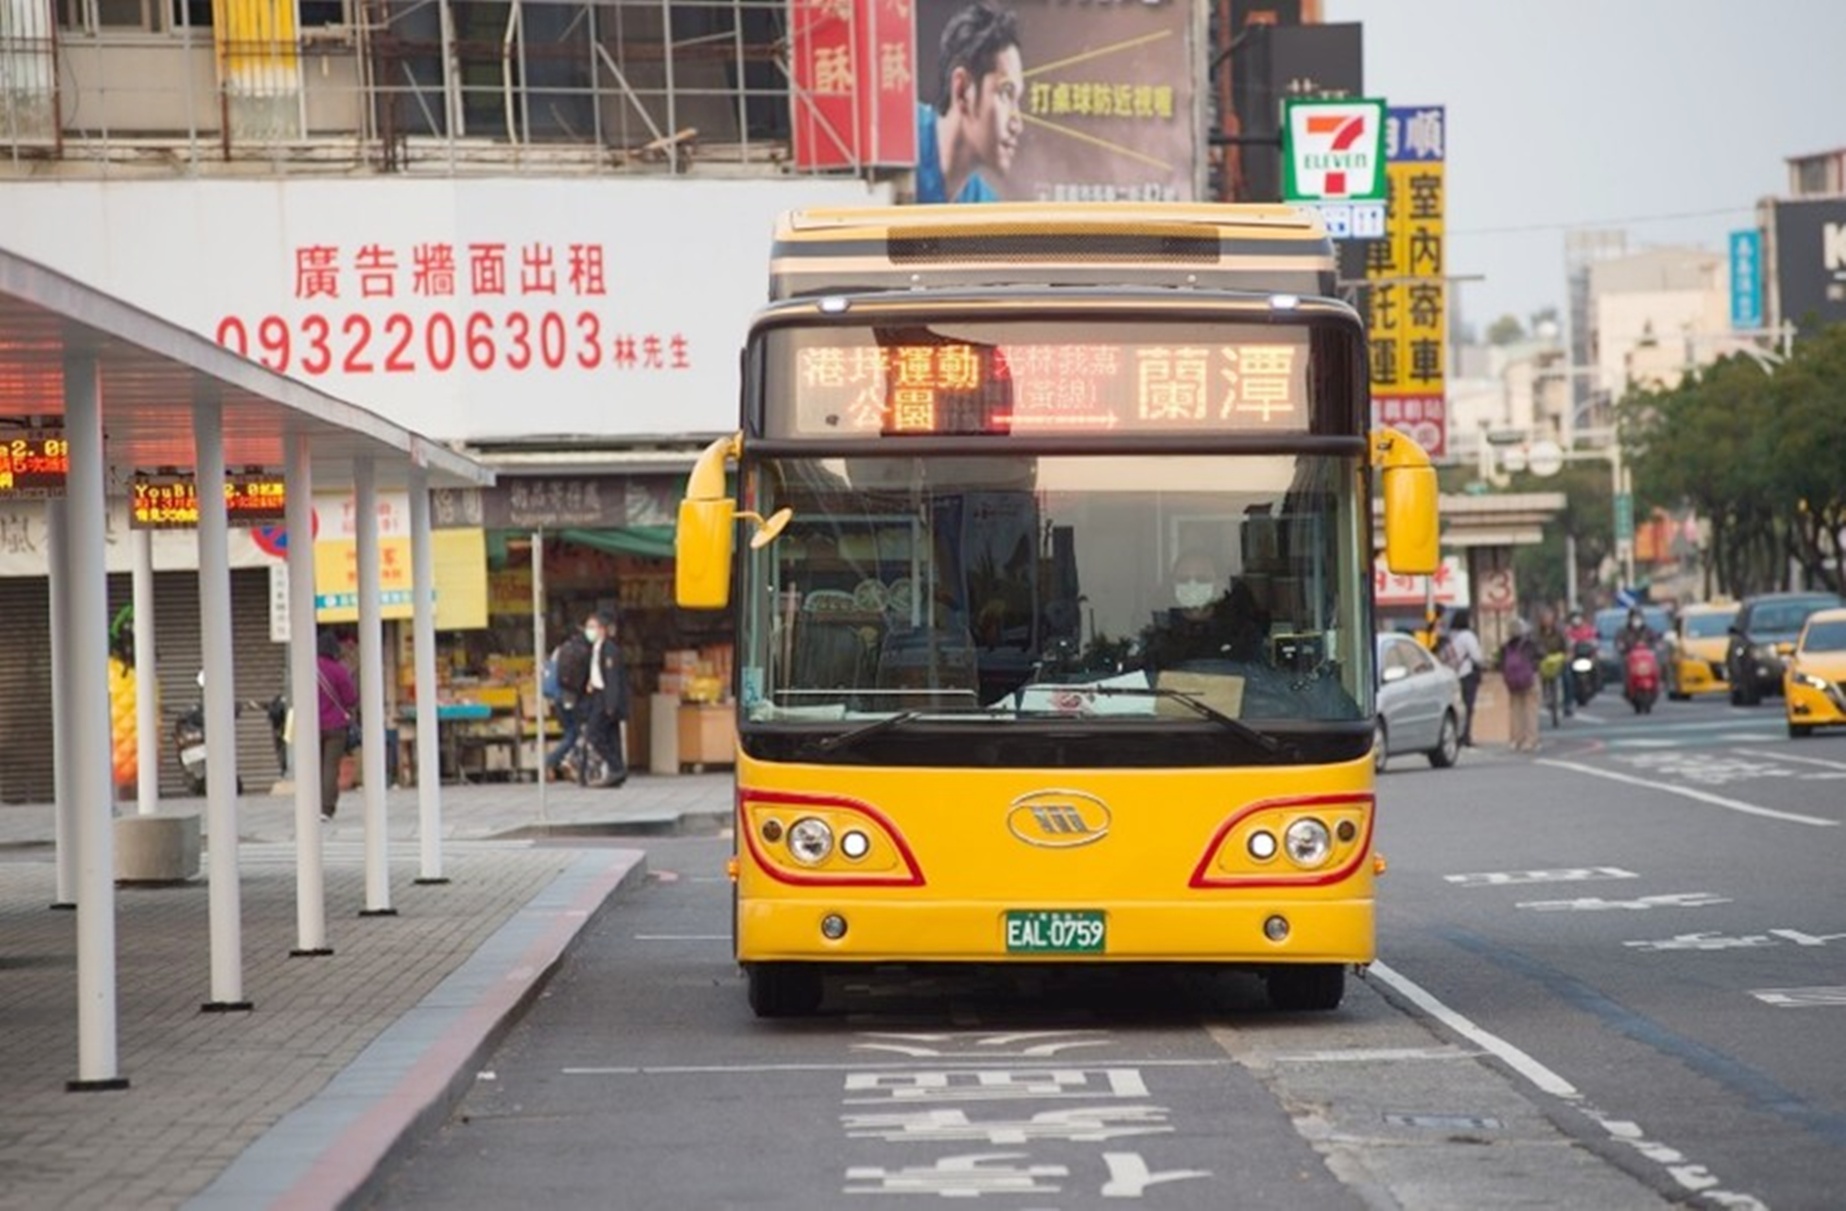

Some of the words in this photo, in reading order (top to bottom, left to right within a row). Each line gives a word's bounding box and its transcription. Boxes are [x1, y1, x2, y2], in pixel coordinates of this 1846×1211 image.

[294, 242, 606, 298] 廣告牆面出租
[1409, 171, 1442, 383] 室內寄車
[215, 311, 602, 375] 0932206303
[613, 333, 692, 369] 林先生
[802, 346, 979, 389] 港坪運動
[849, 387, 934, 430] 公園
[1136, 346, 1296, 422] 蘭潭
[1007, 920, 1104, 946] EAL-0759
